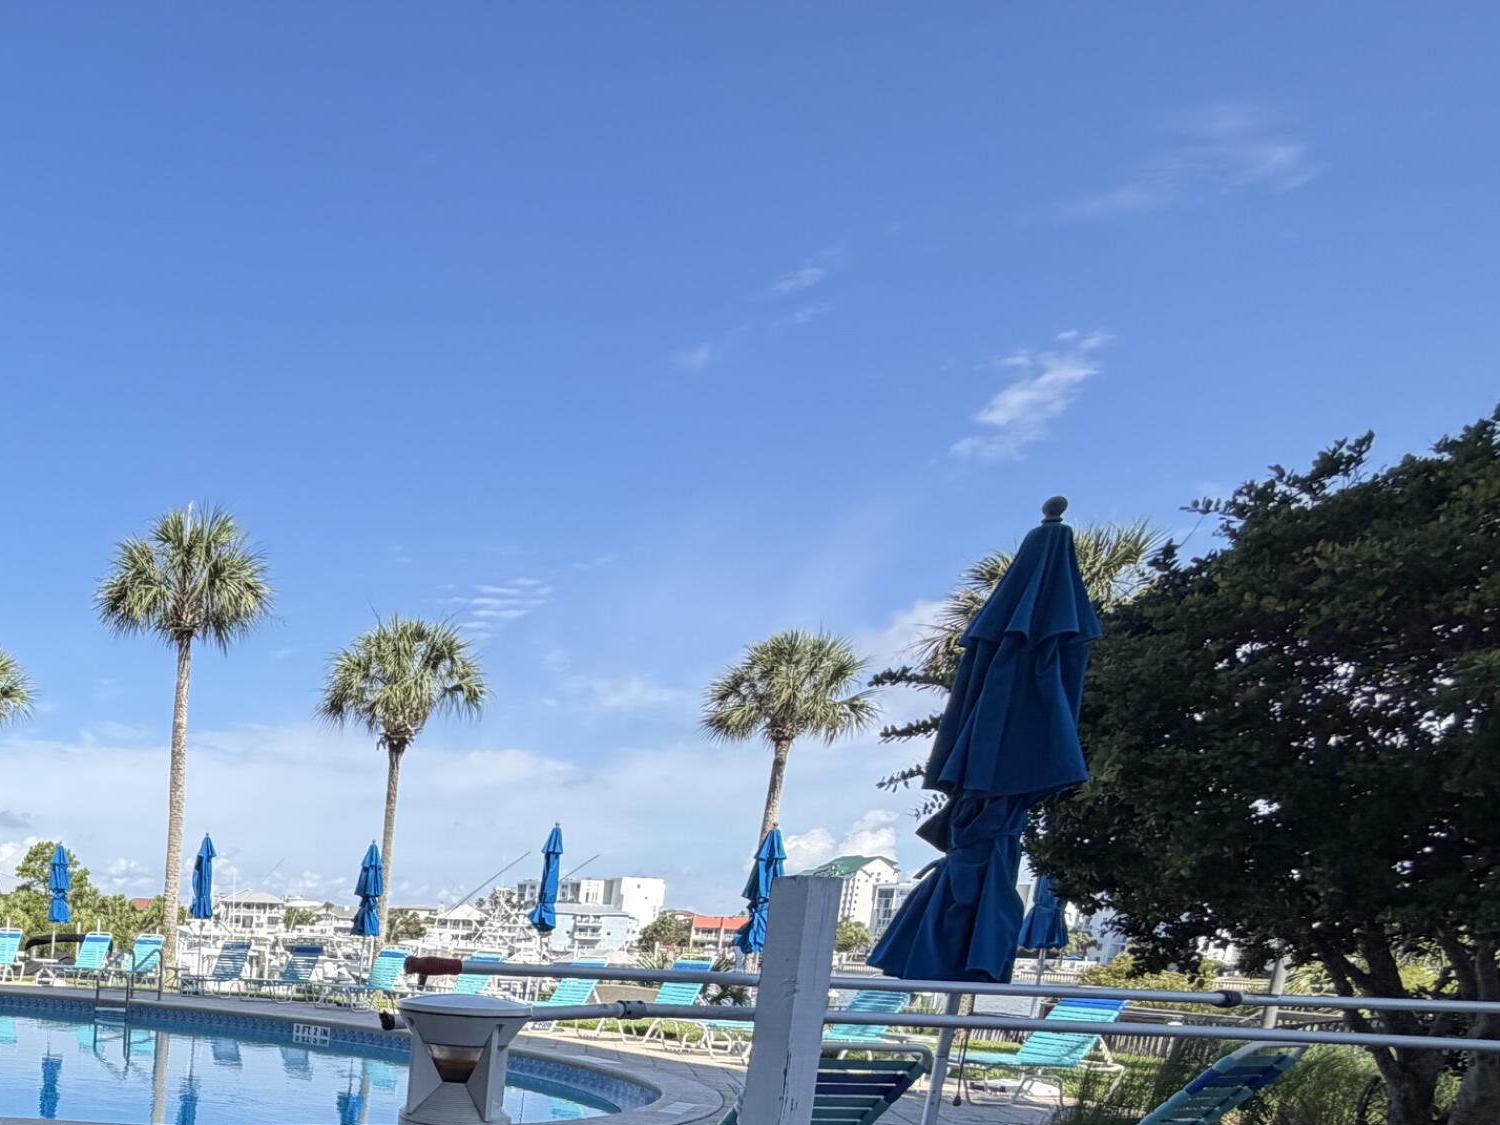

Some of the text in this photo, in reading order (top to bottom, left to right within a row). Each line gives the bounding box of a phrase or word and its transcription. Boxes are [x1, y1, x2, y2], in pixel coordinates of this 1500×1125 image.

[295, 1025, 329, 1038] 3 FT 2 IN
